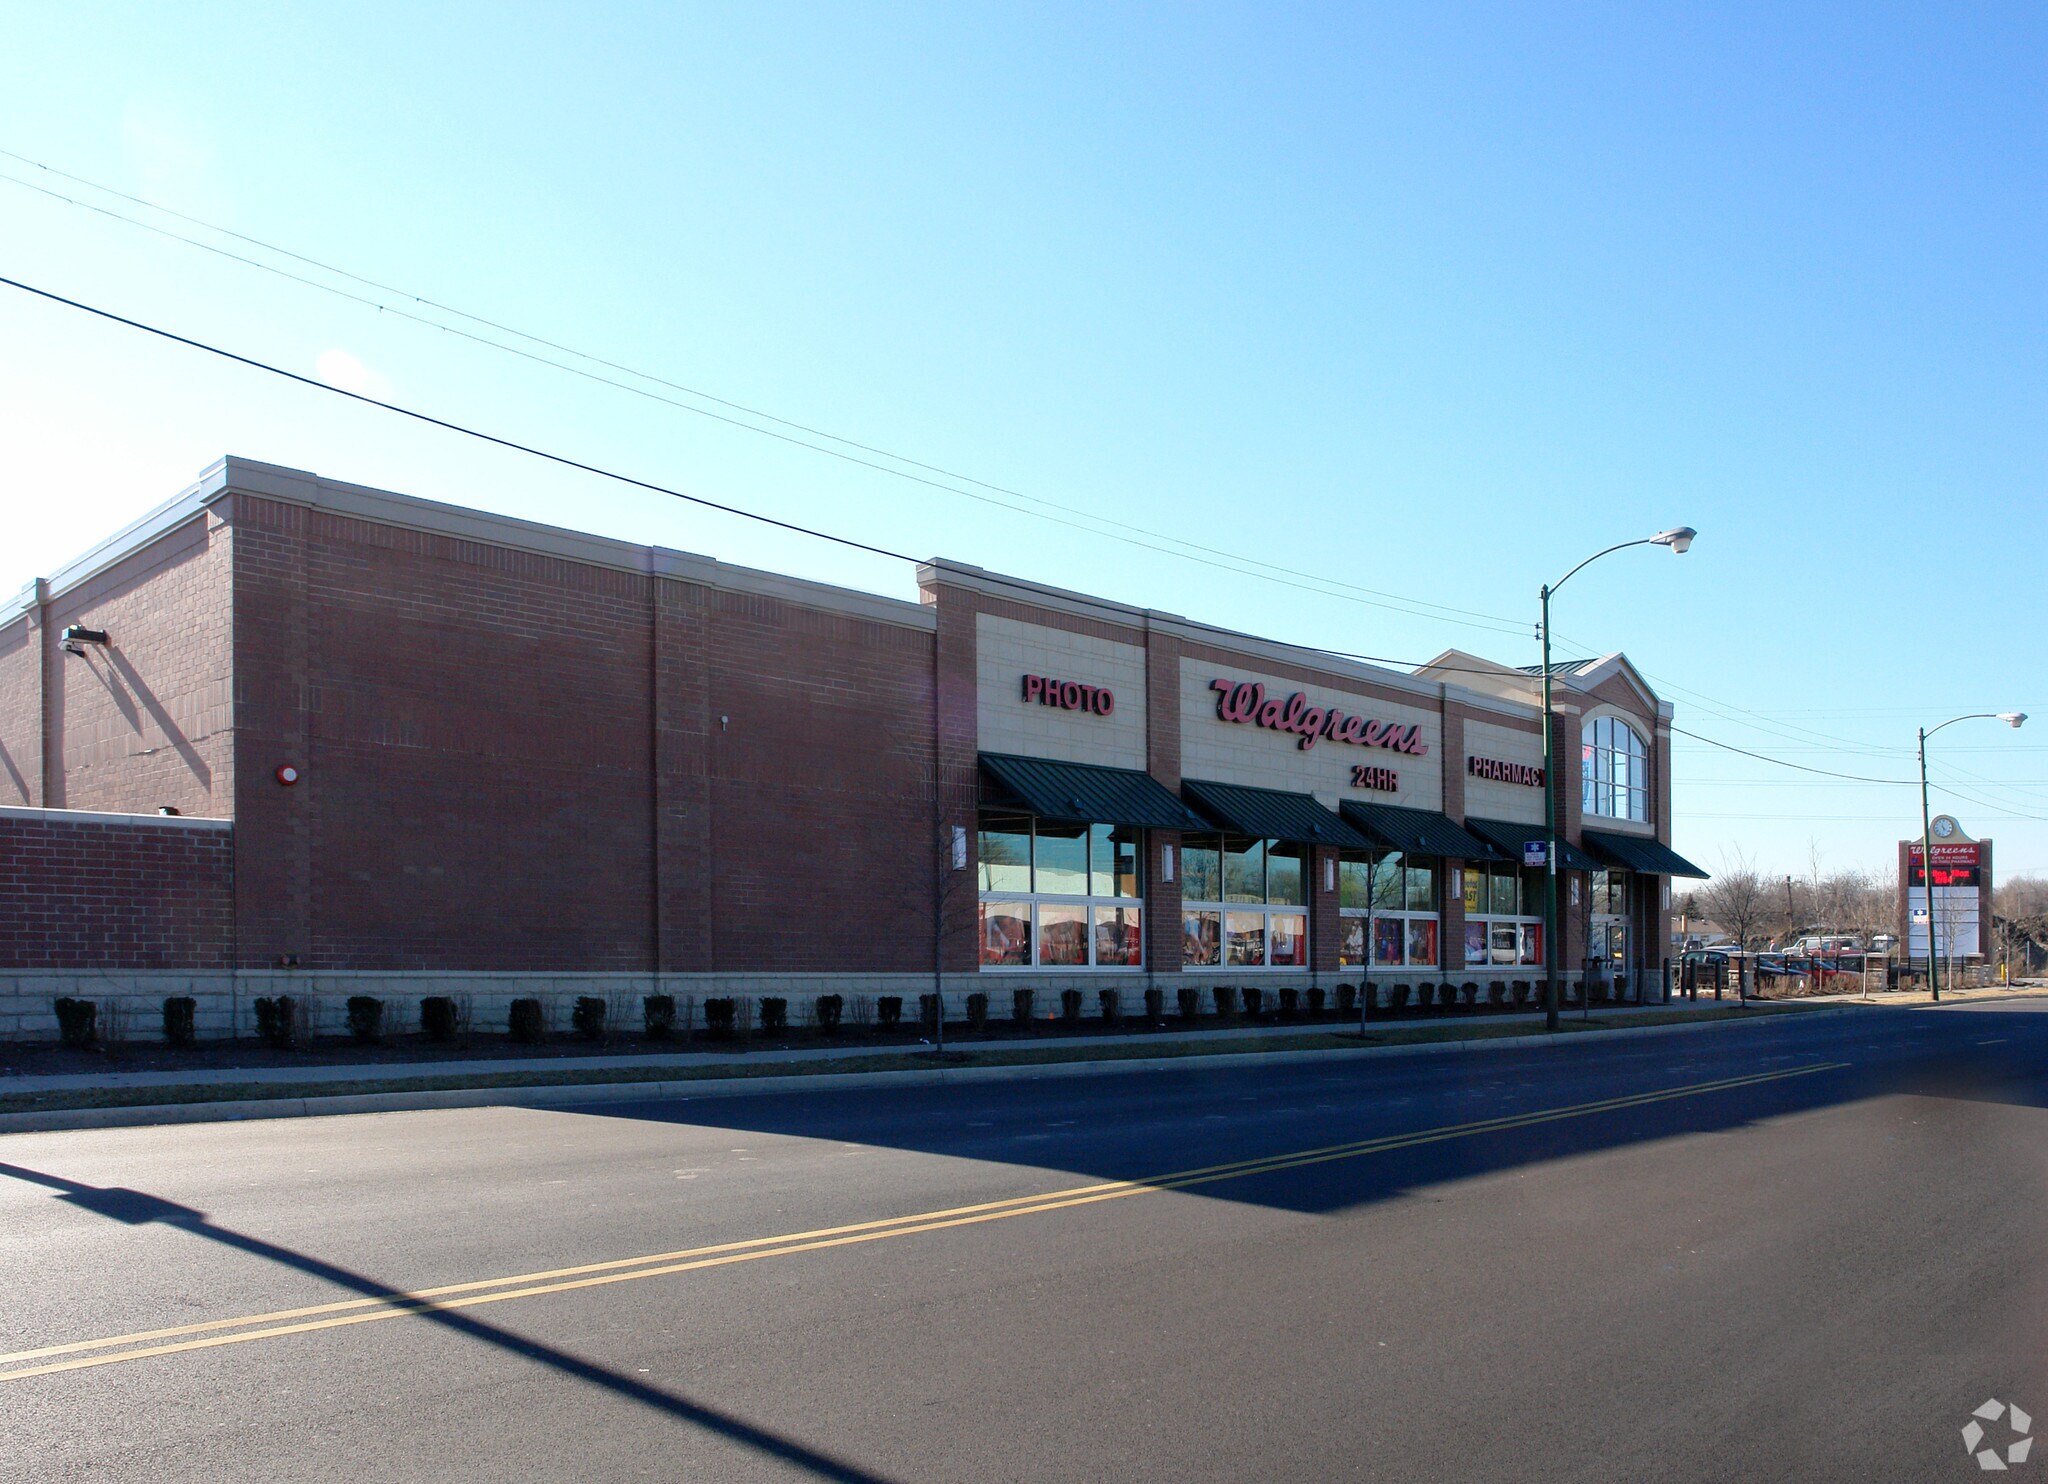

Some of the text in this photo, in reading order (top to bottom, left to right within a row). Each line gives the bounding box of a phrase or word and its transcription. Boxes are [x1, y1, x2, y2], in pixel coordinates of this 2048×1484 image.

[1022, 674, 1115, 716] PHOTO
[1209, 678, 1429, 755] Walgreens
[1351, 765, 1399, 792] 24HR
[1910, 846, 1975, 855] Wlgreens
